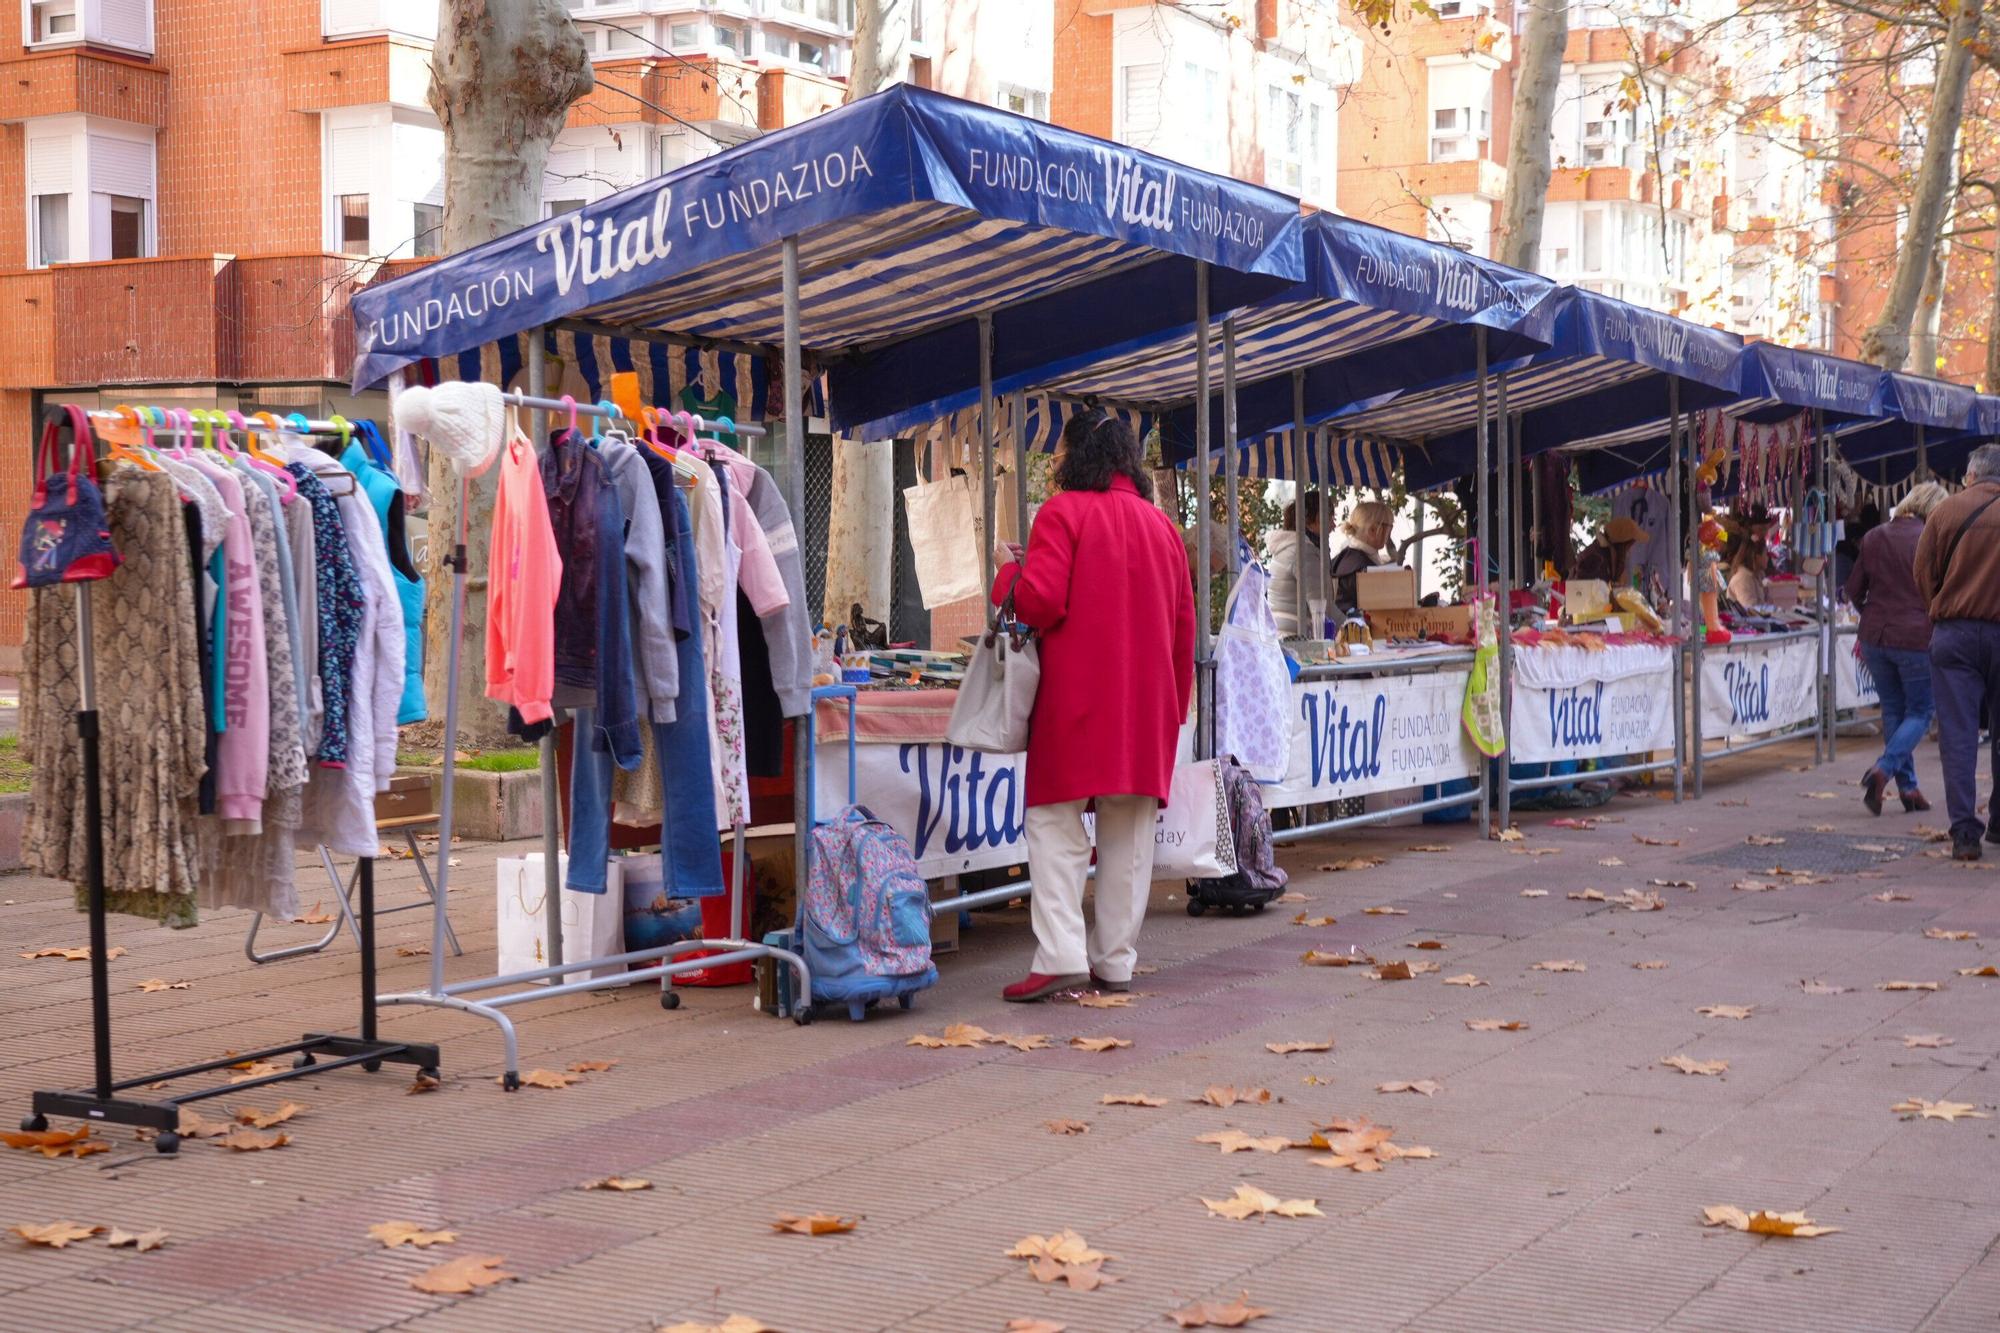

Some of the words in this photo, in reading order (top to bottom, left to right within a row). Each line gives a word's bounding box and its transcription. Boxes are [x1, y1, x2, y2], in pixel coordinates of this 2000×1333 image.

[968, 148, 1092, 205] FUNDACIÓN
[1093, 145, 1174, 232] Vital
[1181, 197, 1264, 250] FUNDAZIOA
[367, 267, 534, 353] FUNDACIÓN
[536, 187, 672, 297] Vital
[684, 145, 874, 237] FUNDAZIOA
[1355, 255, 1430, 295] FUNDACIÓN
[1432, 250, 1480, 312] Vital
[1654, 316, 1688, 365] Vital
[1812, 358, 1839, 401] Vital
[225, 559, 253, 729] AWESOME
[1542, 680, 1604, 749] Vital
[1724, 660, 1770, 725] Vital
[1301, 689, 1386, 788] Vital
[899, 743, 1027, 860] Vita
